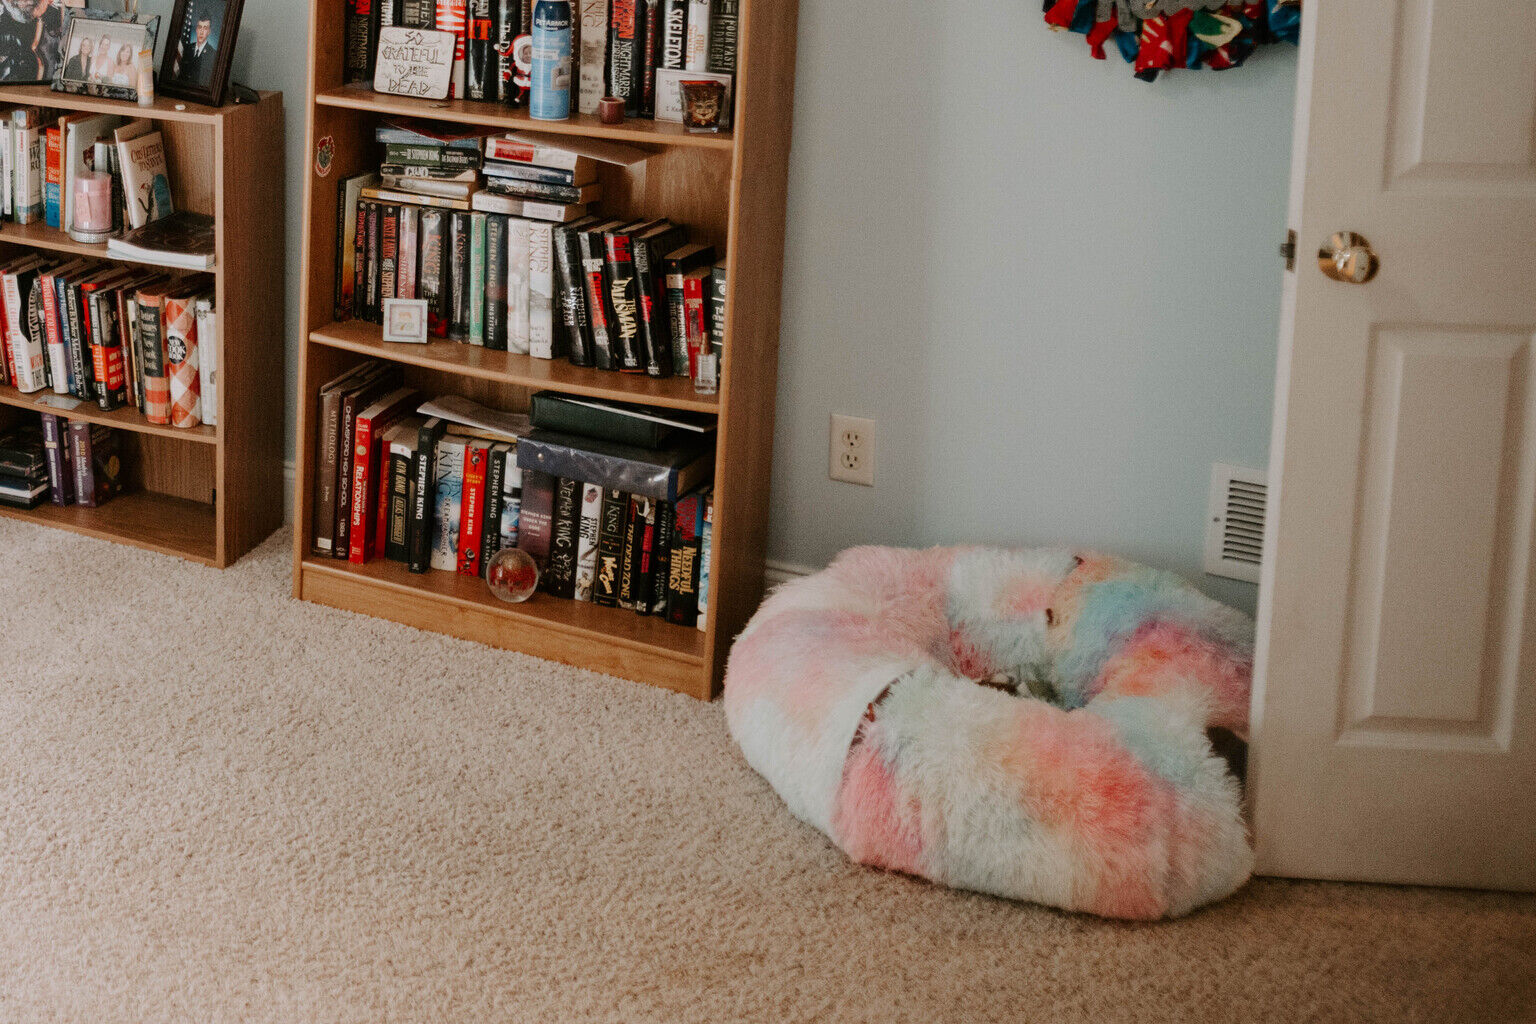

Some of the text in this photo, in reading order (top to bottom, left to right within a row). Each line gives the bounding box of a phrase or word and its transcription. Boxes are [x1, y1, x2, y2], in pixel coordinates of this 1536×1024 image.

[405, 2, 420, 25] THE
[467, 18, 492, 41] IT
[499, 22, 511, 39] The
[381, 45, 445, 65] GRATEFUL
[404, 30, 424, 45] SO
[664, 8, 683, 68] SKELETON
[723, 20, 737, 67] FOUR PAST
[388, 78, 431, 96] DEAD
[619, 41, 633, 97] NIGHTMARES
[381, 216, 396, 297] WASTE LANDS STEPHEN
[421, 234, 442, 275] KING
[455, 232, 466, 264] KING
[489, 222, 498, 288] STEPHEN KING
[529, 228, 539, 271] KING
[539, 228, 549, 273] STEPHEN
[638, 243, 648, 273] STEPHEN
[42, 279, 57, 344] PRIMARY COLORS
[565, 299, 574, 326] PETER
[569, 287, 578, 309] KING
[577, 286, 586, 327] STEPHEN
[611, 277, 637, 338] TALISMAN
[626, 299, 636, 316] THE
[67, 289, 84, 391] Robert Parker Melancholy Baby
[327, 410, 337, 465] MYTHOLOGY
[342, 405, 352, 456] CHELMSFORD
[340, 477, 348, 508] SCHOOL
[415, 454, 427, 520] STEPHEN KING
[437, 450, 453, 495] KING
[451, 451, 463, 497] STEPHEN
[489, 459, 500, 519] STEPHEN KING
[353, 466, 365, 526] RELATIONSHIPS
[392, 460, 406, 543] AYN RAND ATLAS SHRUGGED
[468, 487, 476, 518] STEPHEN
[520, 509, 540, 518] STEPHEN
[556, 477, 575, 548] STEPHEN KING
[440, 498, 451, 557] DREAMCATCHER
[579, 516, 591, 539] KING
[589, 518, 598, 546] STEPHEN
[606, 505, 620, 532] KING
[620, 523, 634, 599] THE DEAD ZONE
[669, 549, 682, 591] THINGS
[679, 546, 697, 595] NEEDFUL
